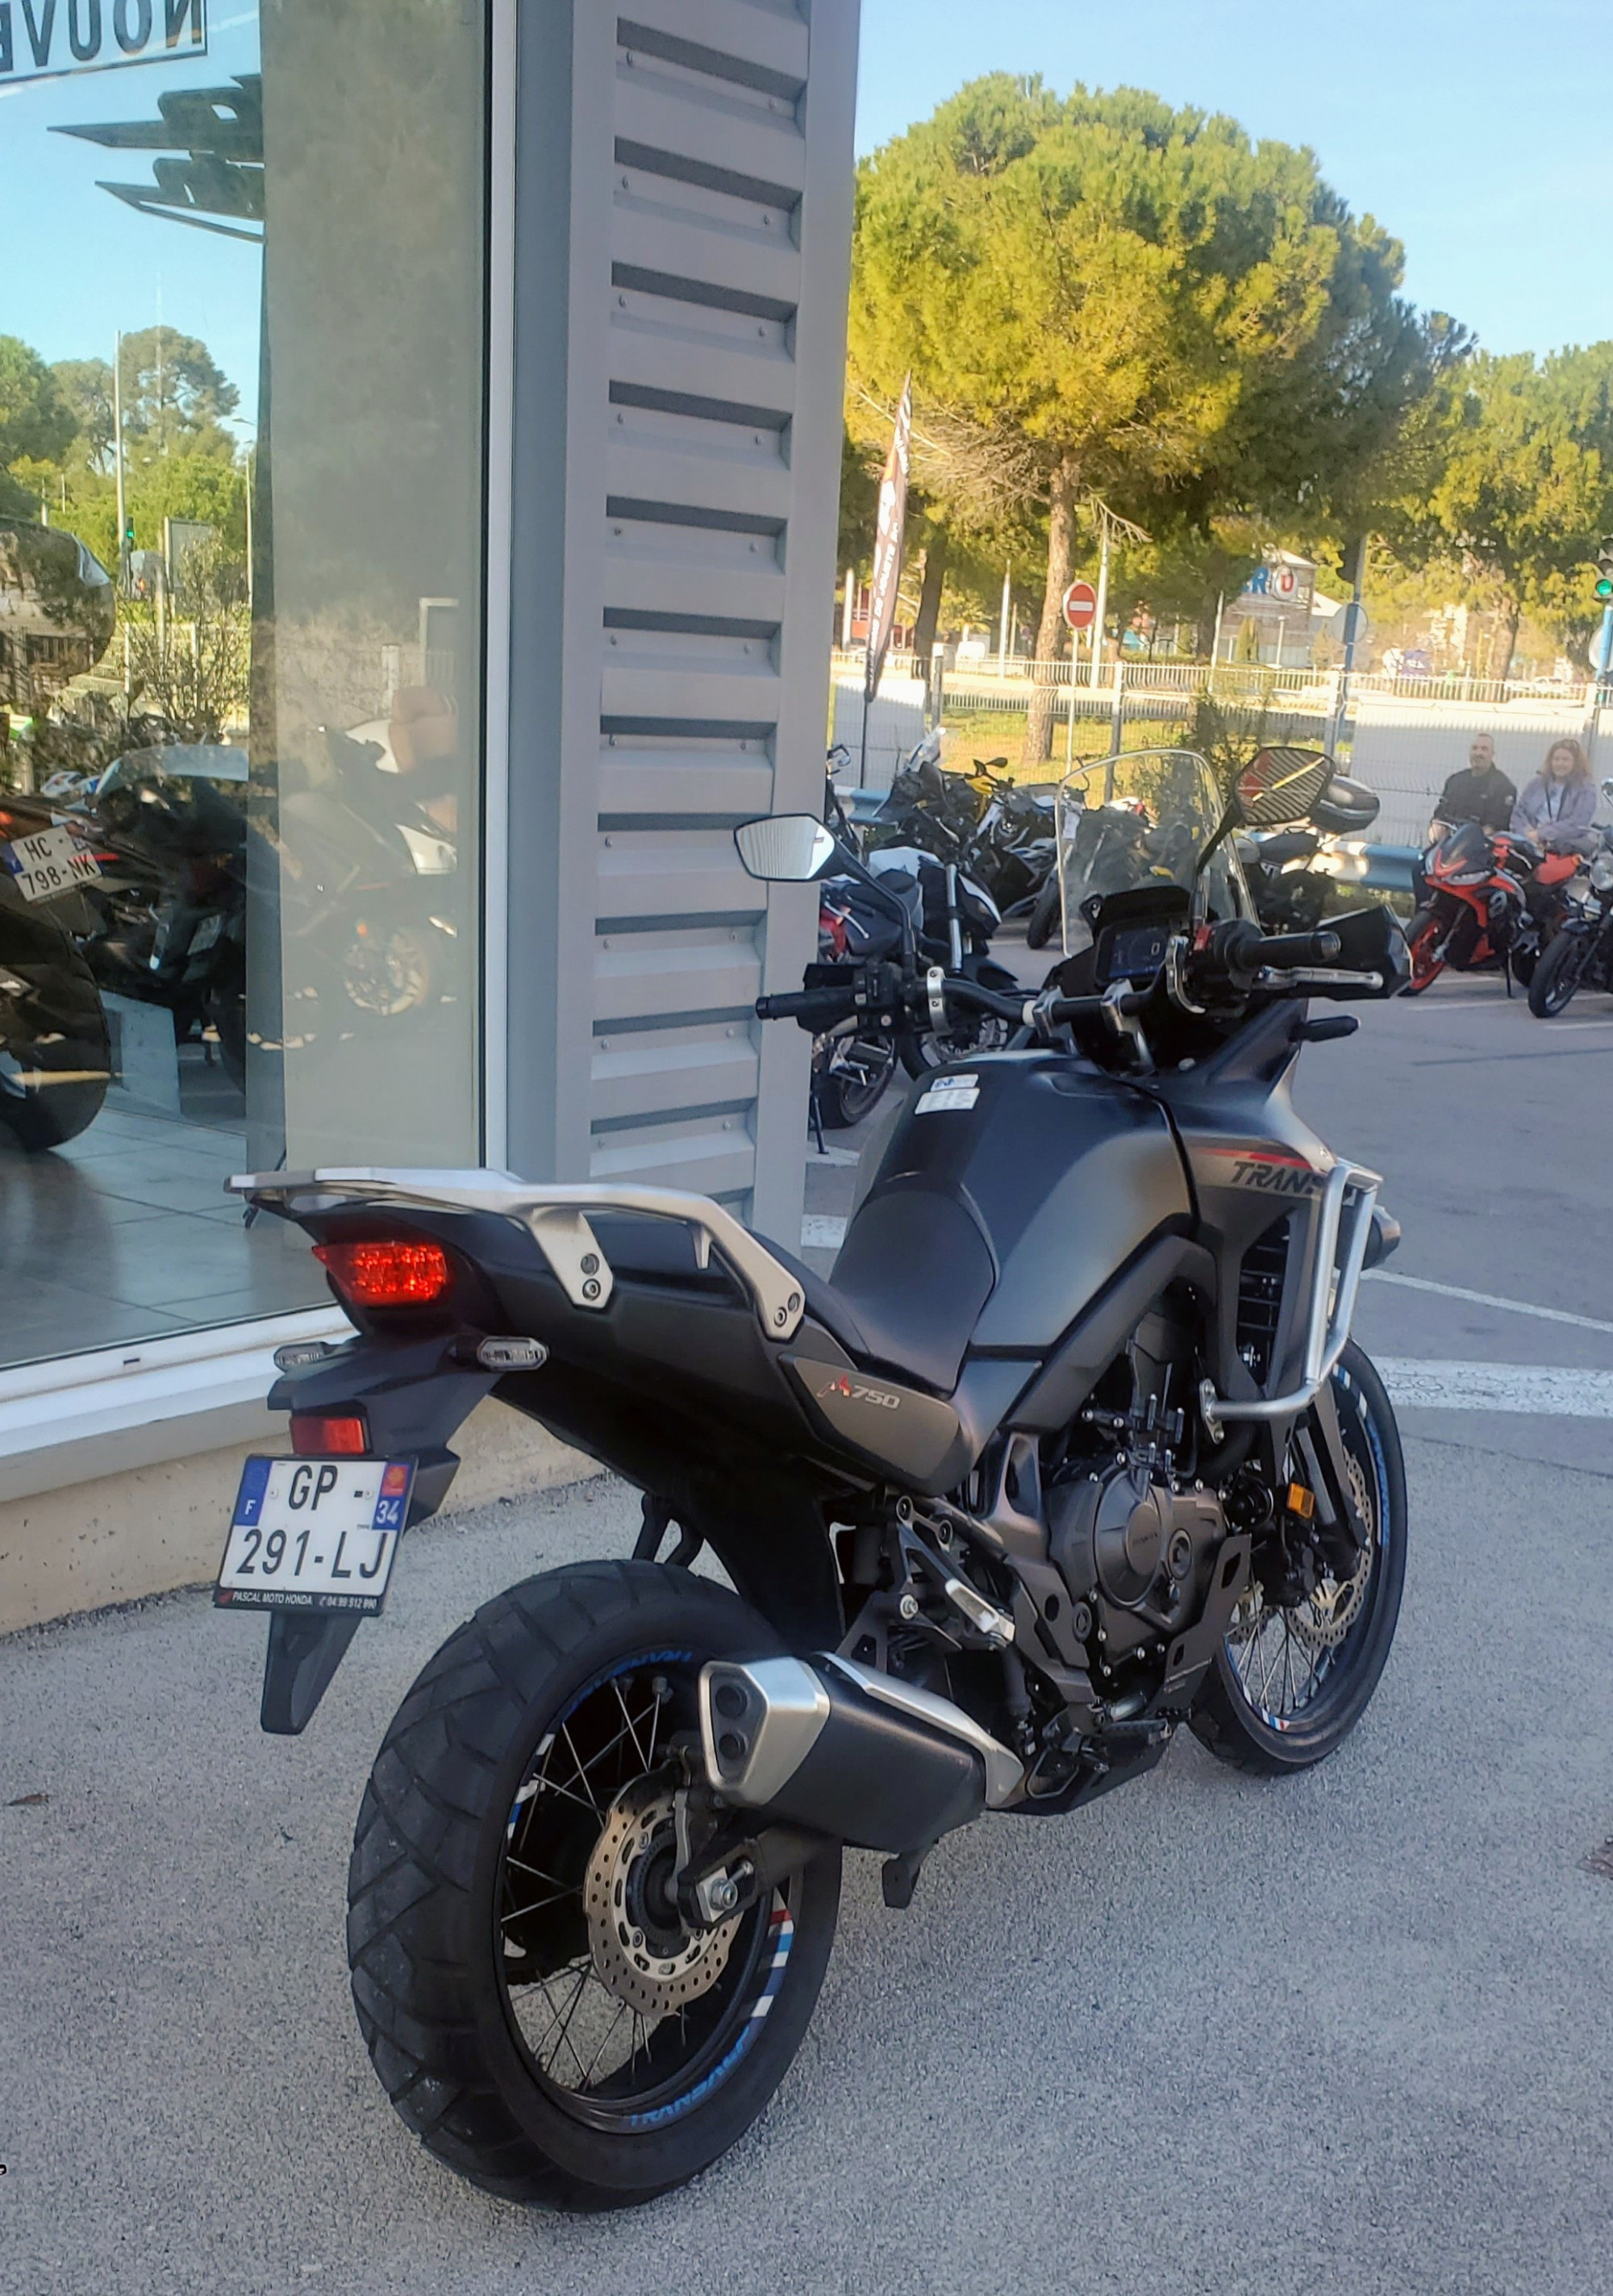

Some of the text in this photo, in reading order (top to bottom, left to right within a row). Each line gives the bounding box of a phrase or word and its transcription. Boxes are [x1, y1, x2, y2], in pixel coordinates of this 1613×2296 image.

[24, 836, 52, 862] HC
[22, 854, 96, 895] 798-NK
[289, 1465, 339, 1511] GP
[244, 1500, 256, 1515] F
[376, 1501, 400, 1523] 34
[235, 1529, 388, 1579] 291-LJ
[232, 1591, 261, 1603] PASCAL
[262, 1593, 285, 1605] MOTO
[285, 1594, 313, 1606] HONDA
